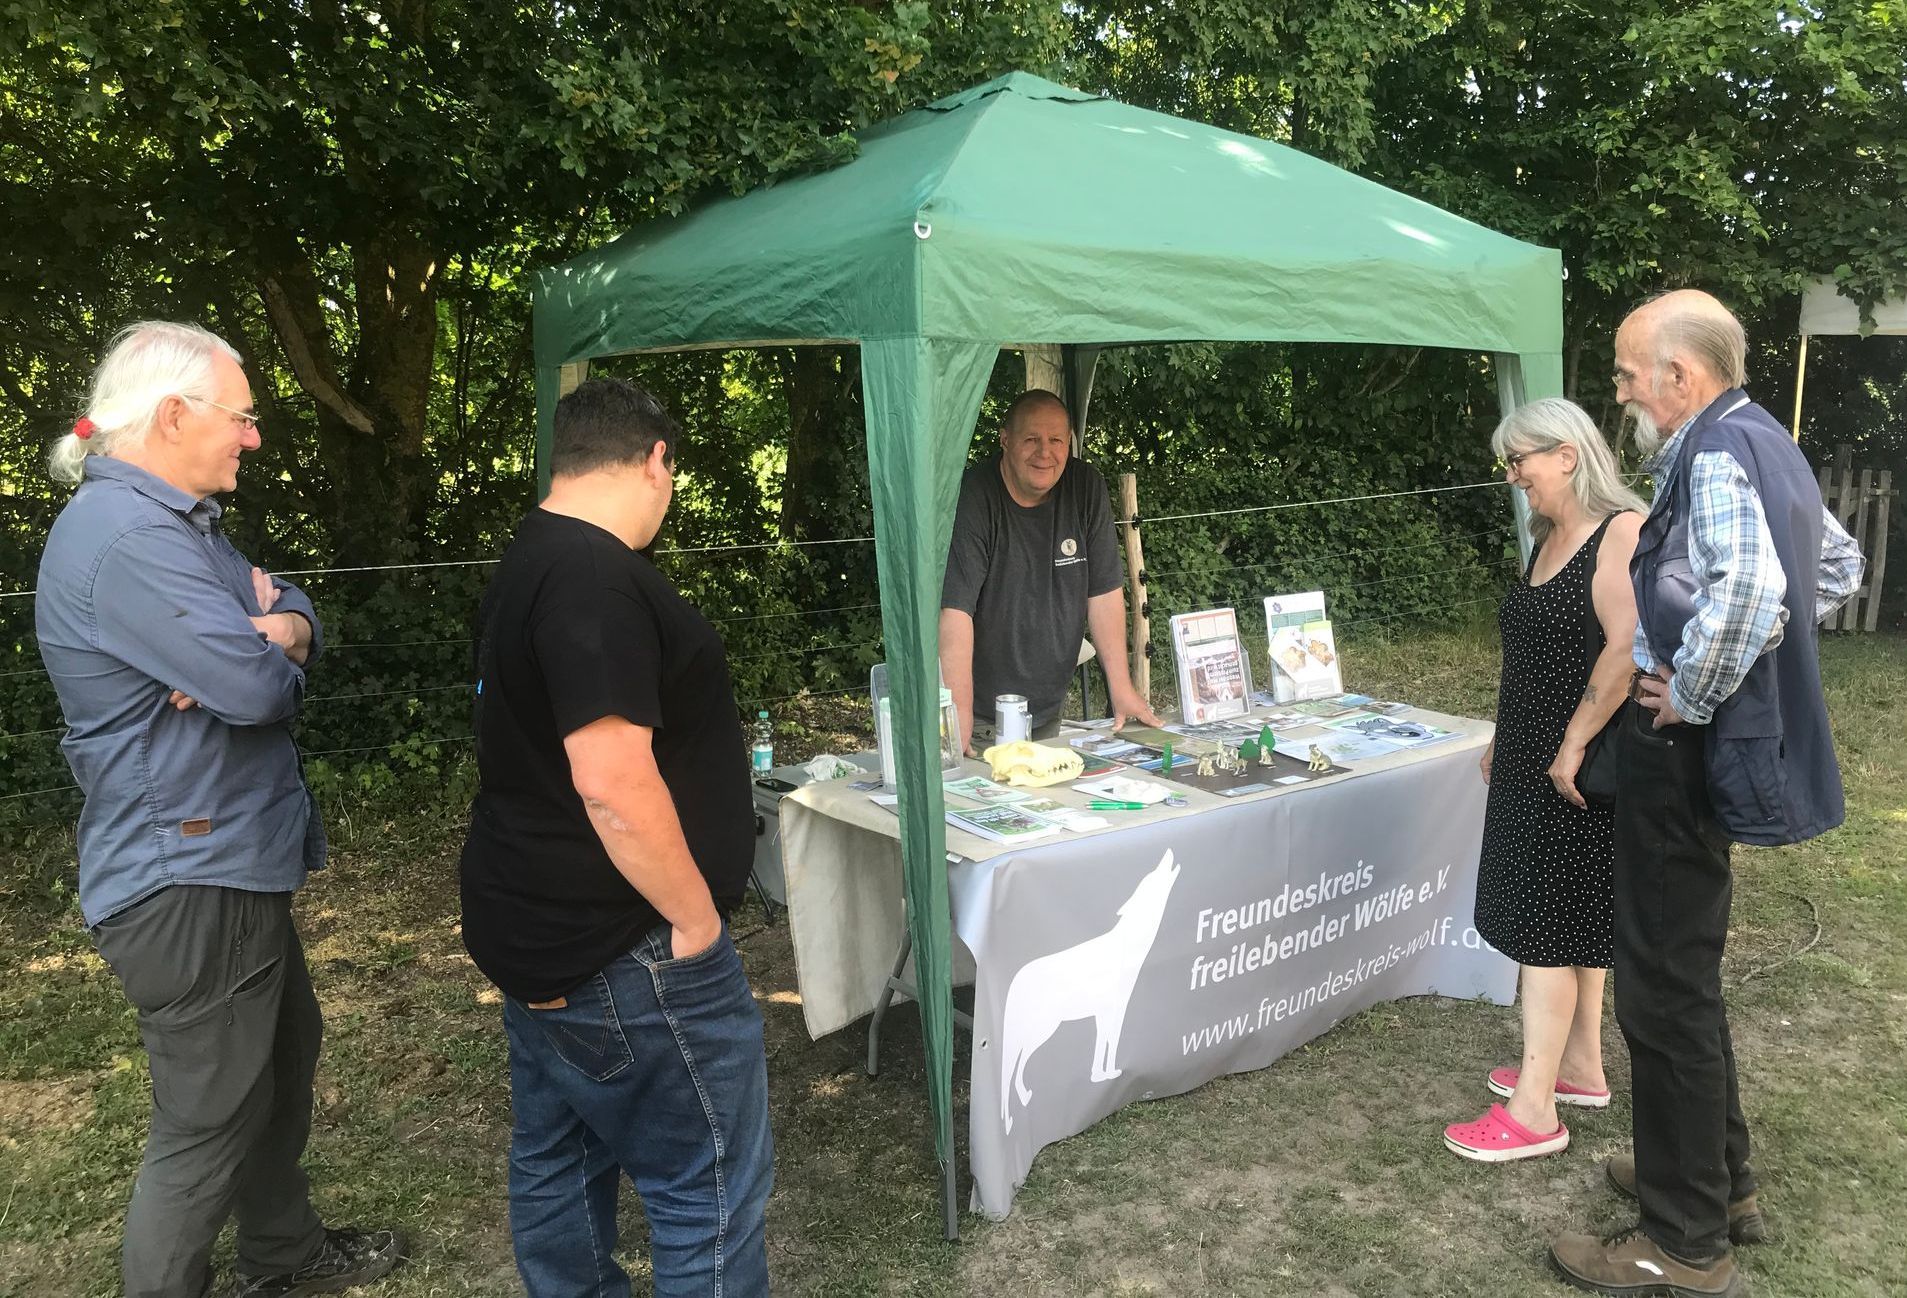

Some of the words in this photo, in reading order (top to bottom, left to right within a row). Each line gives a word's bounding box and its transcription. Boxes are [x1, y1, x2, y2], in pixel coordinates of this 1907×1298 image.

[1190, 913, 1351, 991] freilebender
[1355, 883, 1414, 932] Wölfe
[1196, 859, 1375, 944] Freundeskreis
